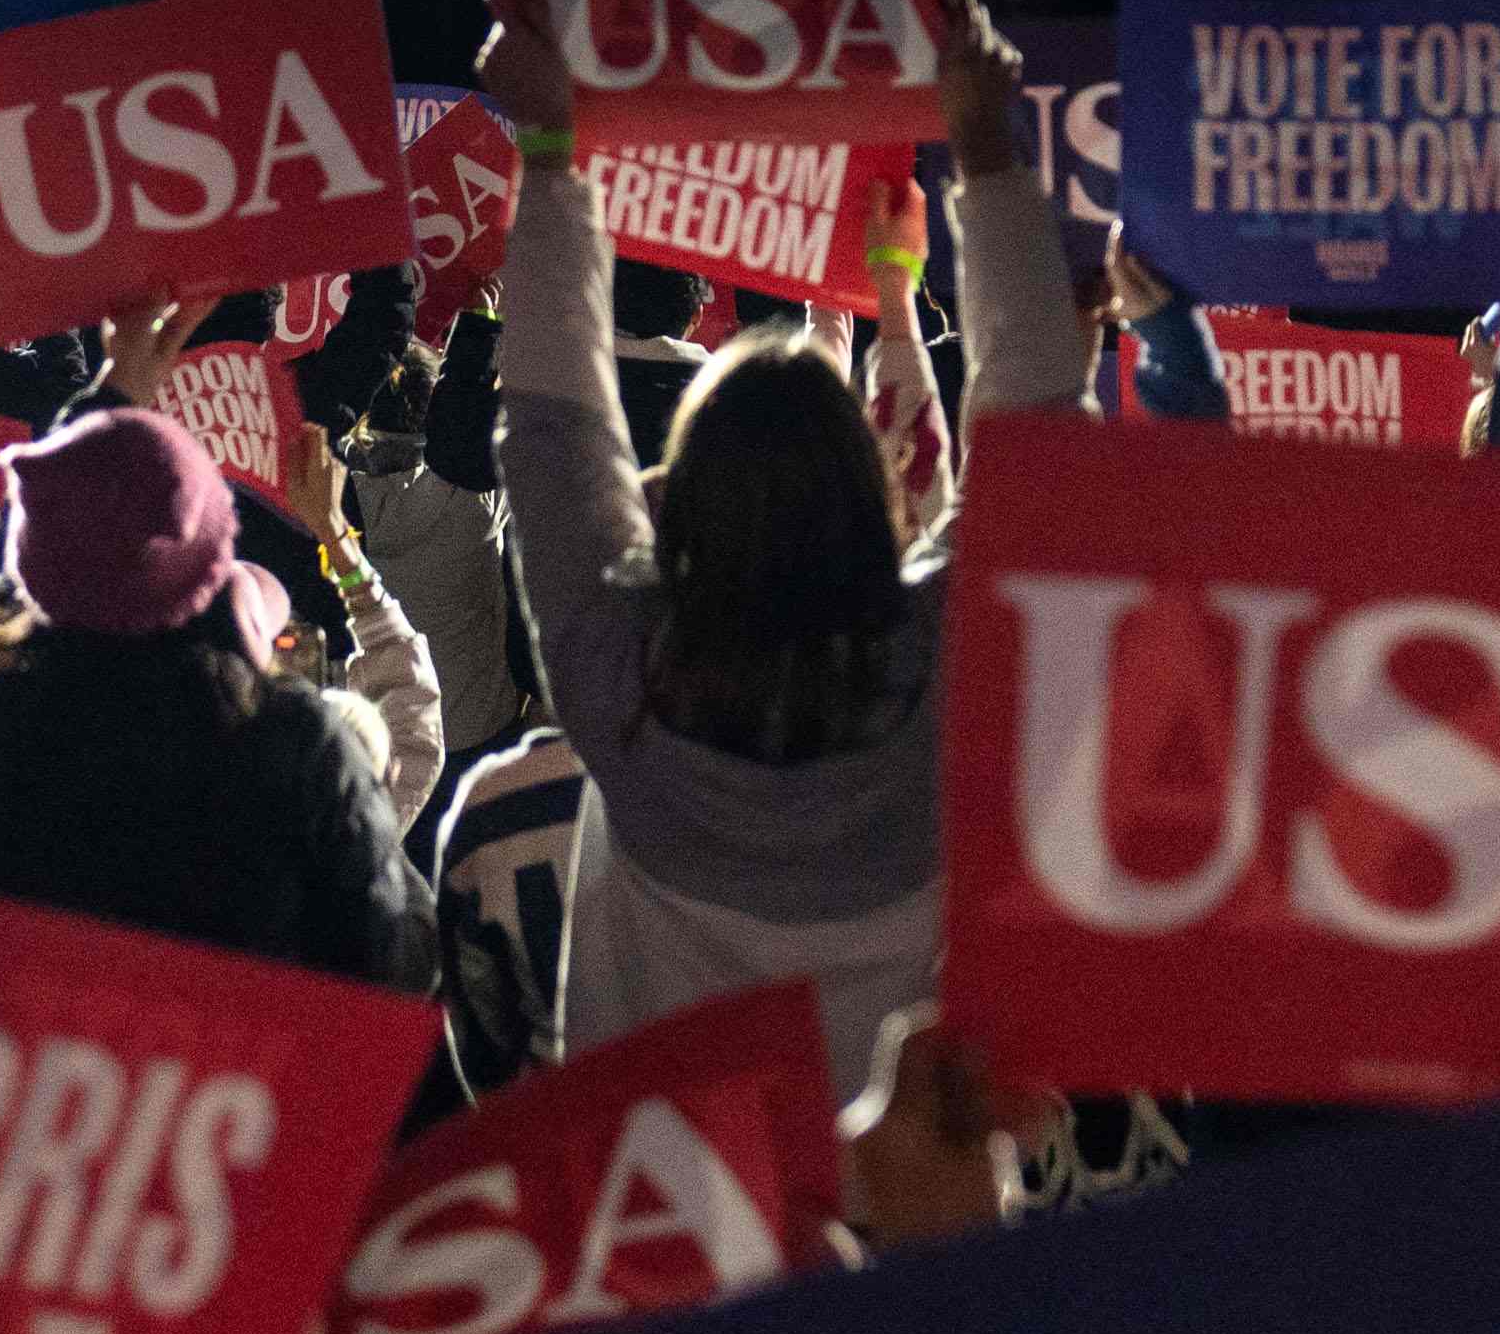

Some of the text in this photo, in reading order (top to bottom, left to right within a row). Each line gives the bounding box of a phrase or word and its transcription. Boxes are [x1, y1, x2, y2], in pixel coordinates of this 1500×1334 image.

[1192, 24, 1361, 118] VOTE
[406, 153, 508, 275] SA
[1219, 349, 1402, 417] REEDOM
